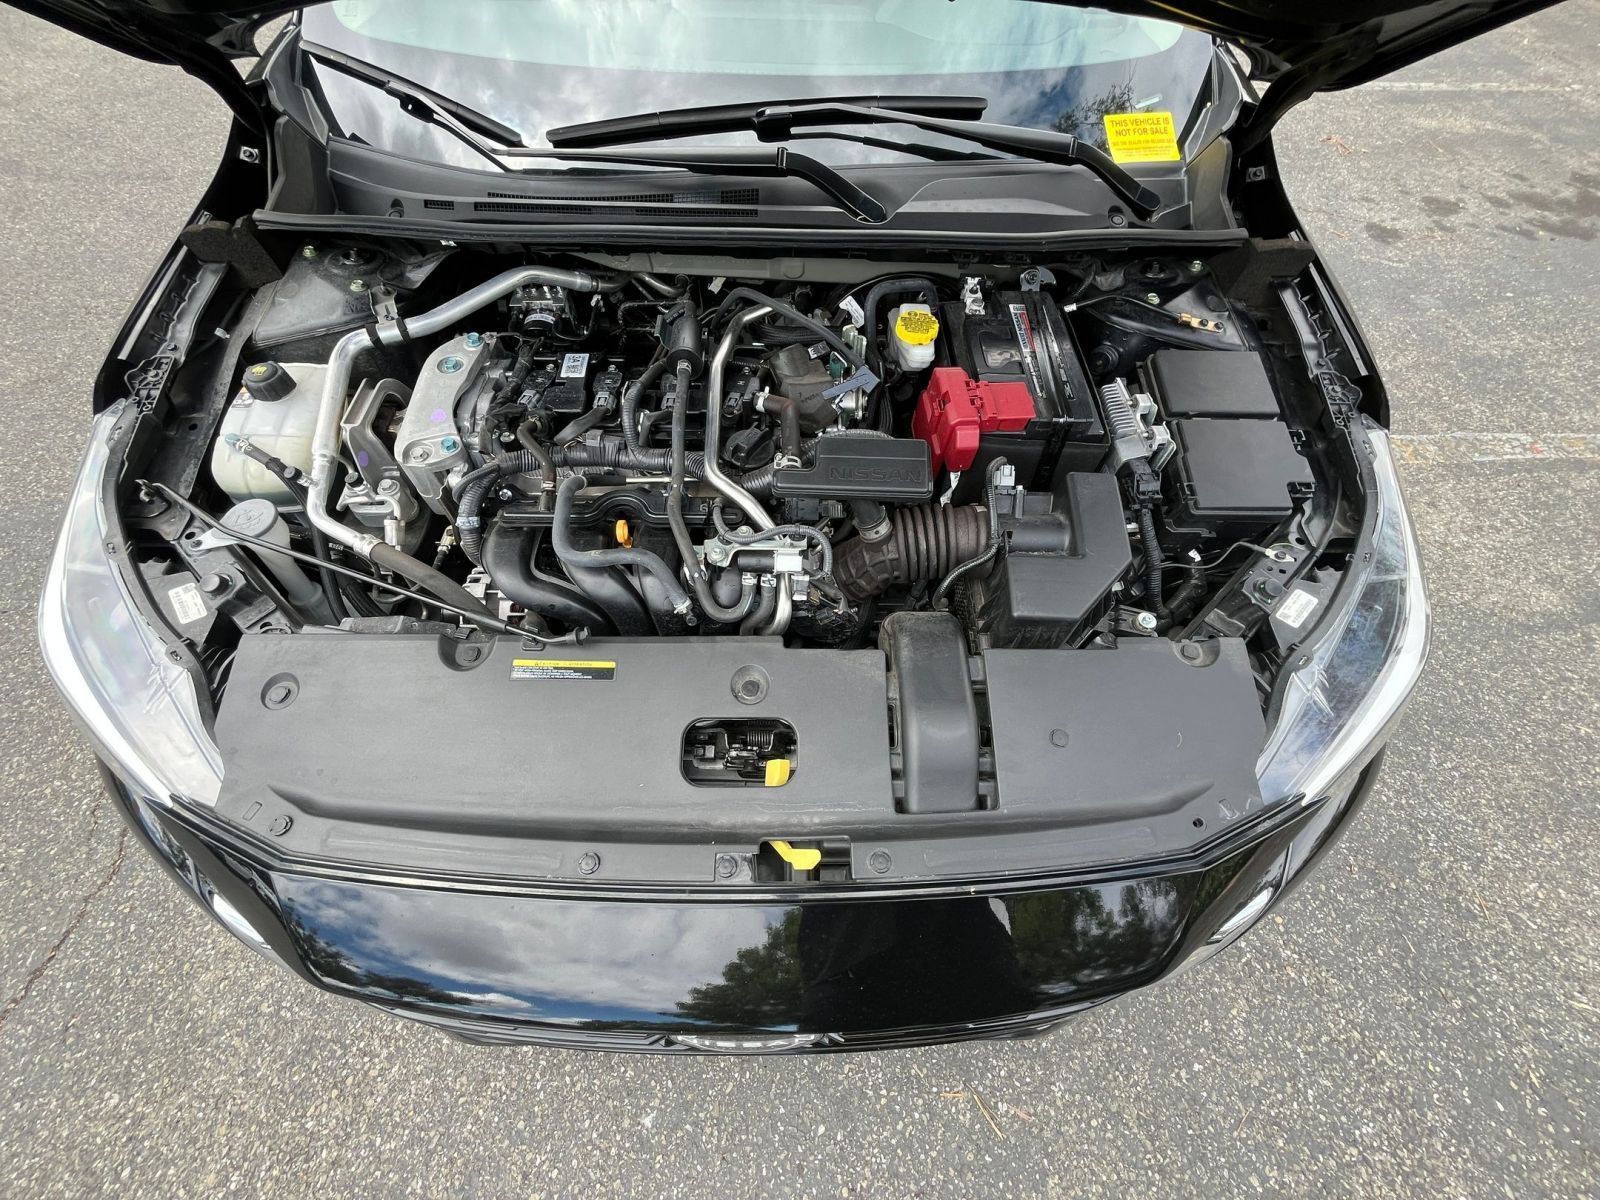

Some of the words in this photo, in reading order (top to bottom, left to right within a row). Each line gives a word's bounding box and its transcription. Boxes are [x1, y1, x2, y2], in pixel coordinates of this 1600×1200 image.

[1110, 119, 1128, 128] THIS
[1129, 117, 1161, 127] VEHICLE
[1162, 117, 1170, 125] IS
[1115, 128, 1132, 137] NOT
[1132, 127, 1149, 136] FOR
[1149, 126, 1169, 135] SALE
[828, 465, 923, 483] NISSAN
